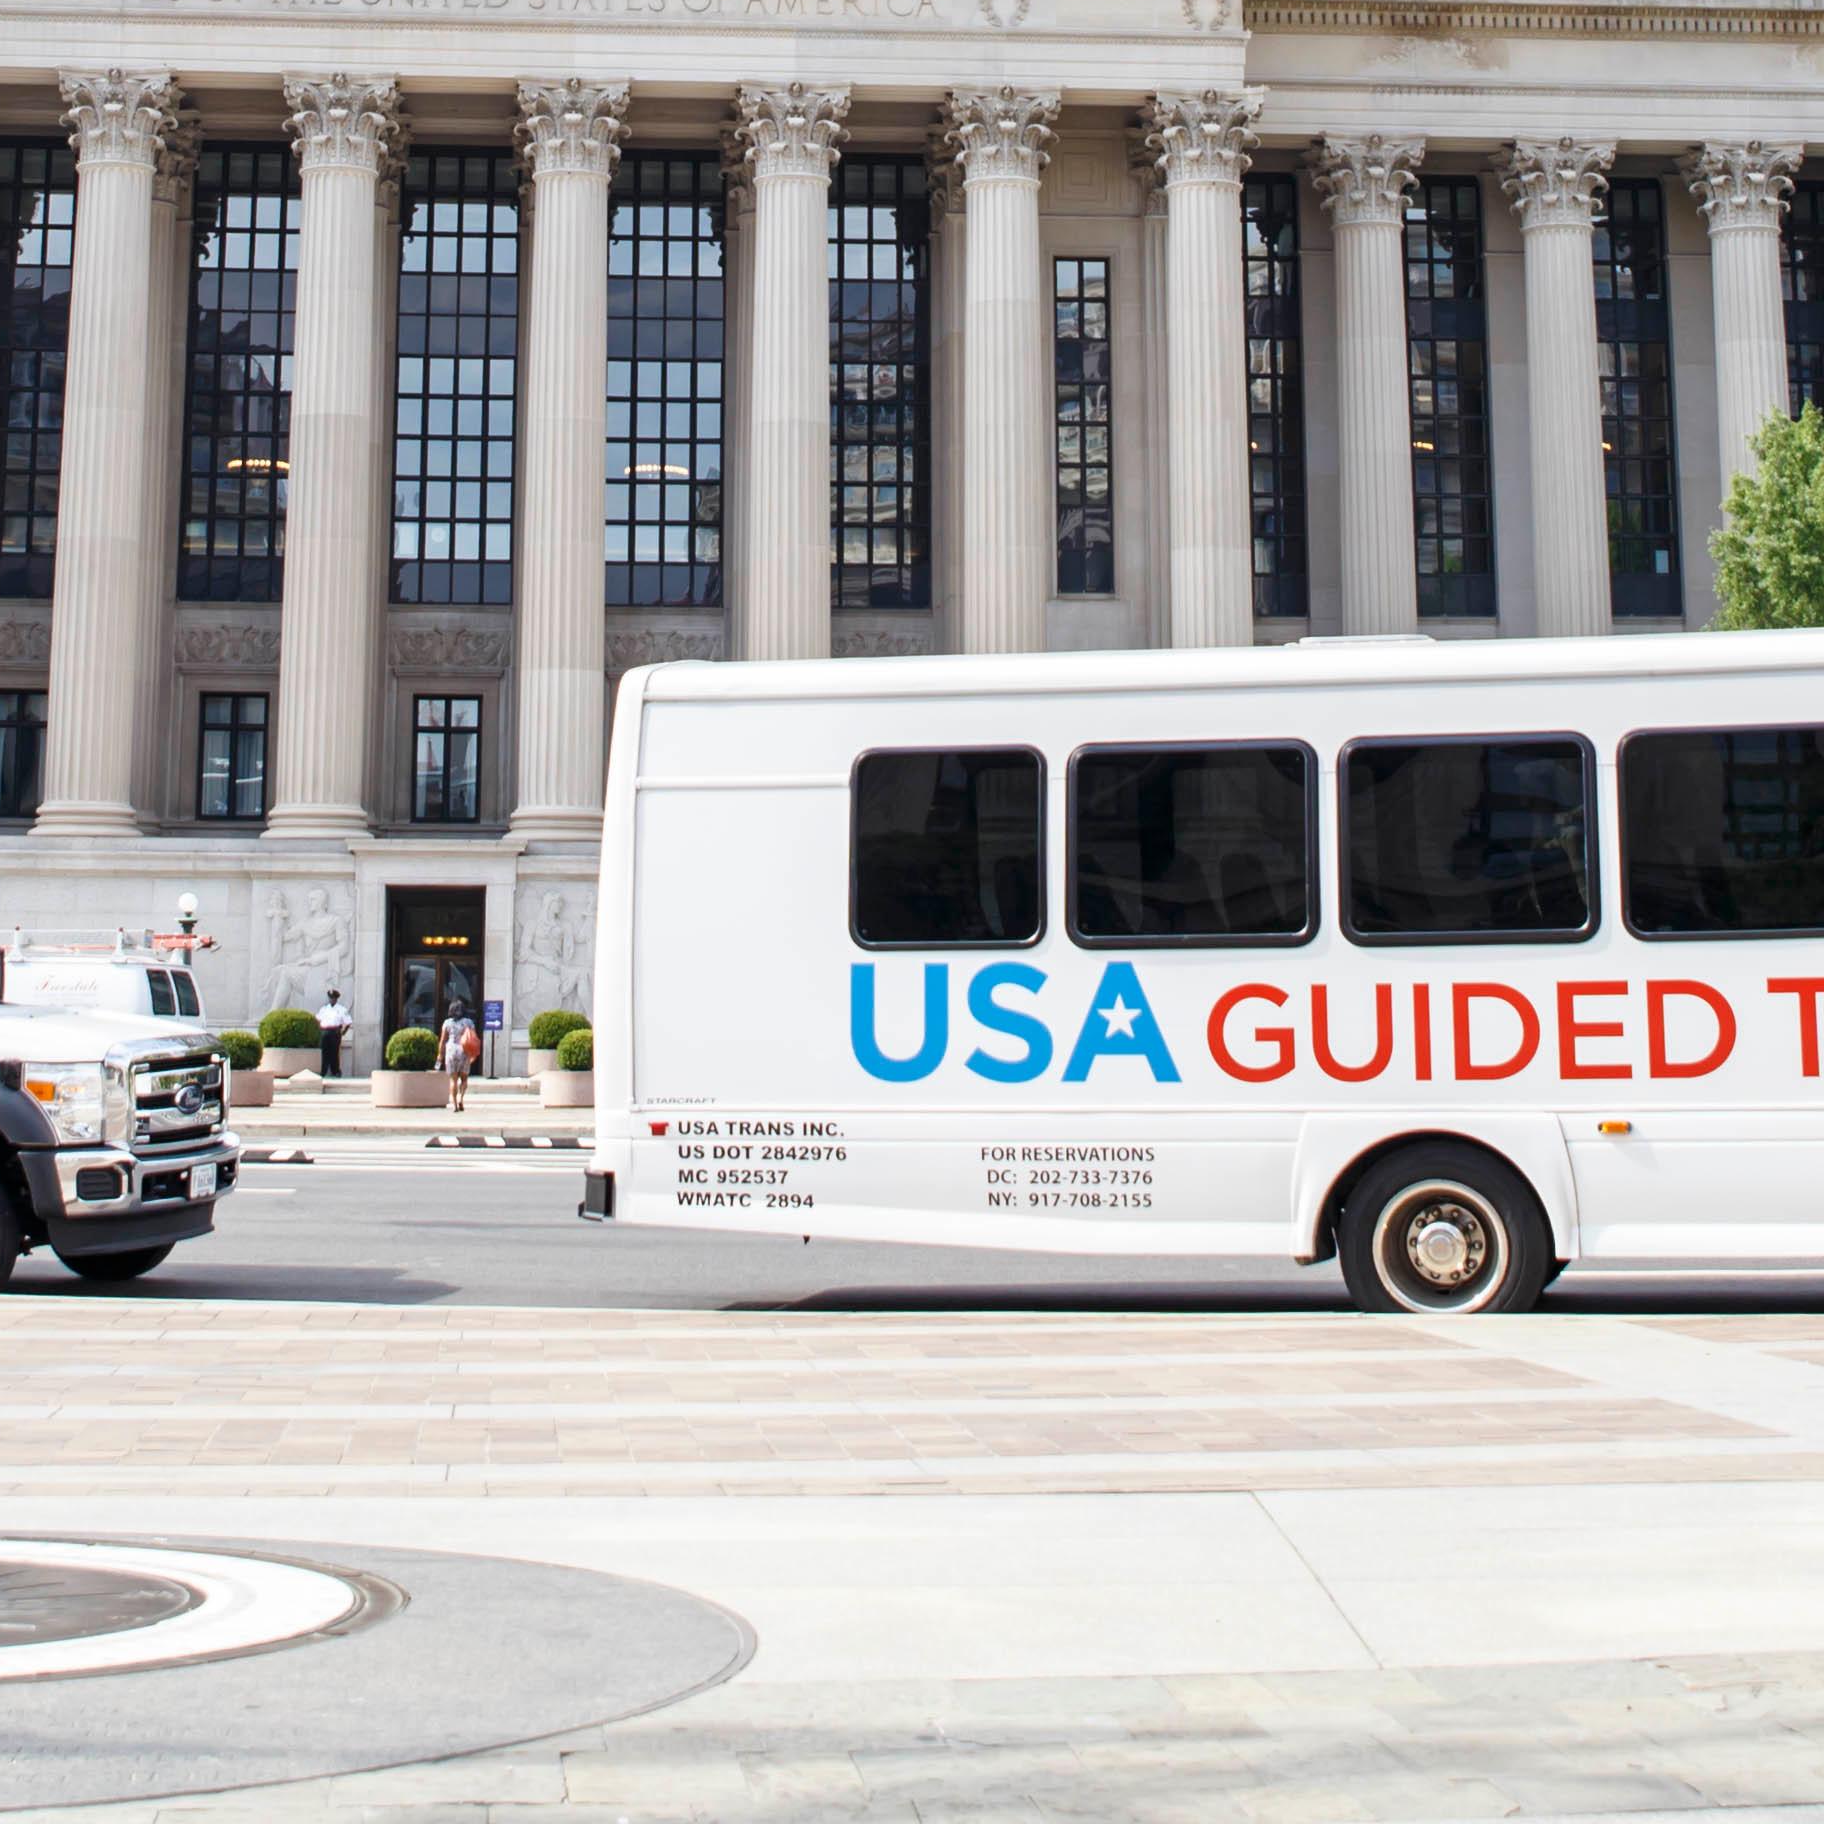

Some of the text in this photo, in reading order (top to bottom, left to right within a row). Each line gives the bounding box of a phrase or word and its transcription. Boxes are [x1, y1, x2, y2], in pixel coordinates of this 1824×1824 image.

[850, 961, 1182, 1083] USA
[1206, 979, 1737, 1083] GUIDED
[646, 1097, 717, 1105] STARCRAFT
[678, 1121, 845, 1137] USA TRANS INC.
[678, 1145, 847, 1161] US DOT 2842976
[981, 1147, 1155, 1161] FOR RESERVATIONS
[678, 1169, 788, 1185] MC 952537
[987, 1169, 1153, 1185] DC: 202-733-7376
[677, 1192, 815, 1209] WMATC 2894
[988, 1192, 1152, 1208] NY: 917-708-2155
